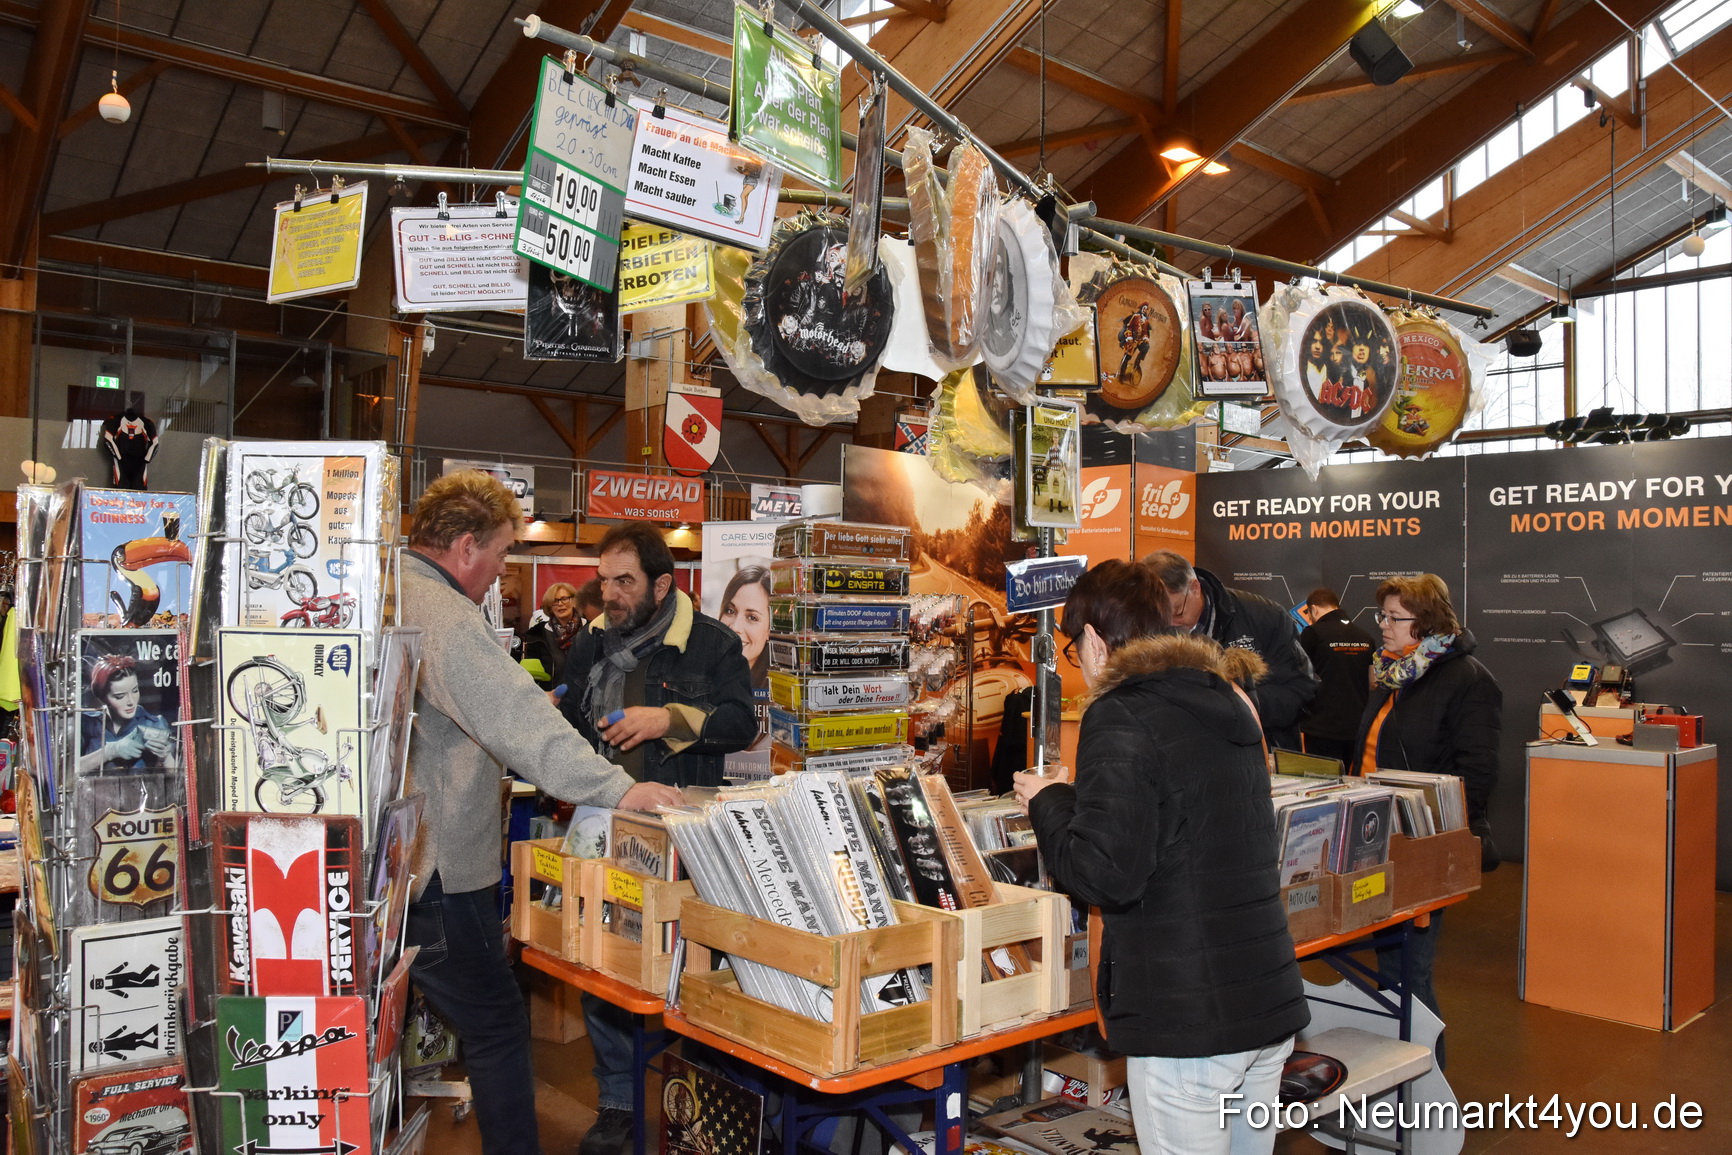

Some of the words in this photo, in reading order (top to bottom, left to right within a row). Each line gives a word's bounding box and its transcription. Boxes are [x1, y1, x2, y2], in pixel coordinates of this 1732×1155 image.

[758, 110, 781, 133] war
[788, 100, 807, 125] der
[809, 111, 832, 141] Plan
[646, 122, 677, 140] Frauen
[680, 132, 691, 144] an
[694, 136, 708, 149] die
[641, 144, 670, 162] Macht
[673, 152, 702, 170] Kaffee
[638, 162, 668, 180] Macht
[669, 171, 696, 187] Essen
[556, 172, 598, 213] 19.00
[634, 180, 664, 198] Macht
[666, 189, 697, 207] sauber
[481, 233, 515, 241] SCHNE
[545, 222, 590, 264] 50.00
[332, 469, 359, 478] Million
[592, 475, 700, 503] ZWEIRAD
[1490, 486, 1537, 506] GET
[1546, 479, 1637, 504] READY
[1646, 476, 1704, 498] FOR
[128, 498, 147, 510] day
[150, 499, 165, 508] for
[334, 507, 348, 515] aus
[624, 508, 645, 517] was
[647, 508, 680, 519] sonst?
[758, 500, 801, 514] MEYE
[1213, 500, 1250, 517] GET
[1256, 497, 1324, 516] READY
[1330, 494, 1371, 512] FOR
[1378, 490, 1440, 510] YOUR
[90, 511, 145, 524] GUINNESS
[1511, 511, 1605, 532] MOTOR
[1617, 505, 1732, 529] MOMEN
[721, 533, 747, 541] CARE
[838, 532, 854, 541] liebe
[856, 534, 869, 542] Gott
[870, 535, 886, 543] sieht
[887, 536, 902, 544] alles
[1229, 522, 1301, 540] MOTOR
[1310, 518, 1421, 538] MOMENTS
[137, 641, 160, 660] We
[165, 644, 180, 660] ca
[314, 644, 325, 677] QUICKLY
[332, 649, 348, 669] NSU
[154, 667, 171, 687] do
[823, 686, 838, 695] Halt
[842, 685, 860, 694] Dein
[863, 684, 882, 693] Wort
[838, 695, 853, 704] oder
[875, 694, 895, 702] Fresse
[845, 726, 854, 736] der
[855, 726, 863, 735] will
[865, 726, 873, 734] nur
[107, 817, 173, 838] ROUTE
[827, 781, 863, 852] ECHTE
[752, 807, 793, 873] ECHTE
[104, 843, 175, 896] 66
[753, 858, 793, 927] Mercede
[224, 867, 251, 982] Kawasaki
[328, 871, 354, 982] SERVICE
[226, 1025, 357, 1071] Vespa
[103, 1086, 130, 1096] FULL
[134, 1076, 178, 1090] SERVICE
[119, 1106, 157, 1123] Mechanic
[261, 1111, 326, 1129] only
